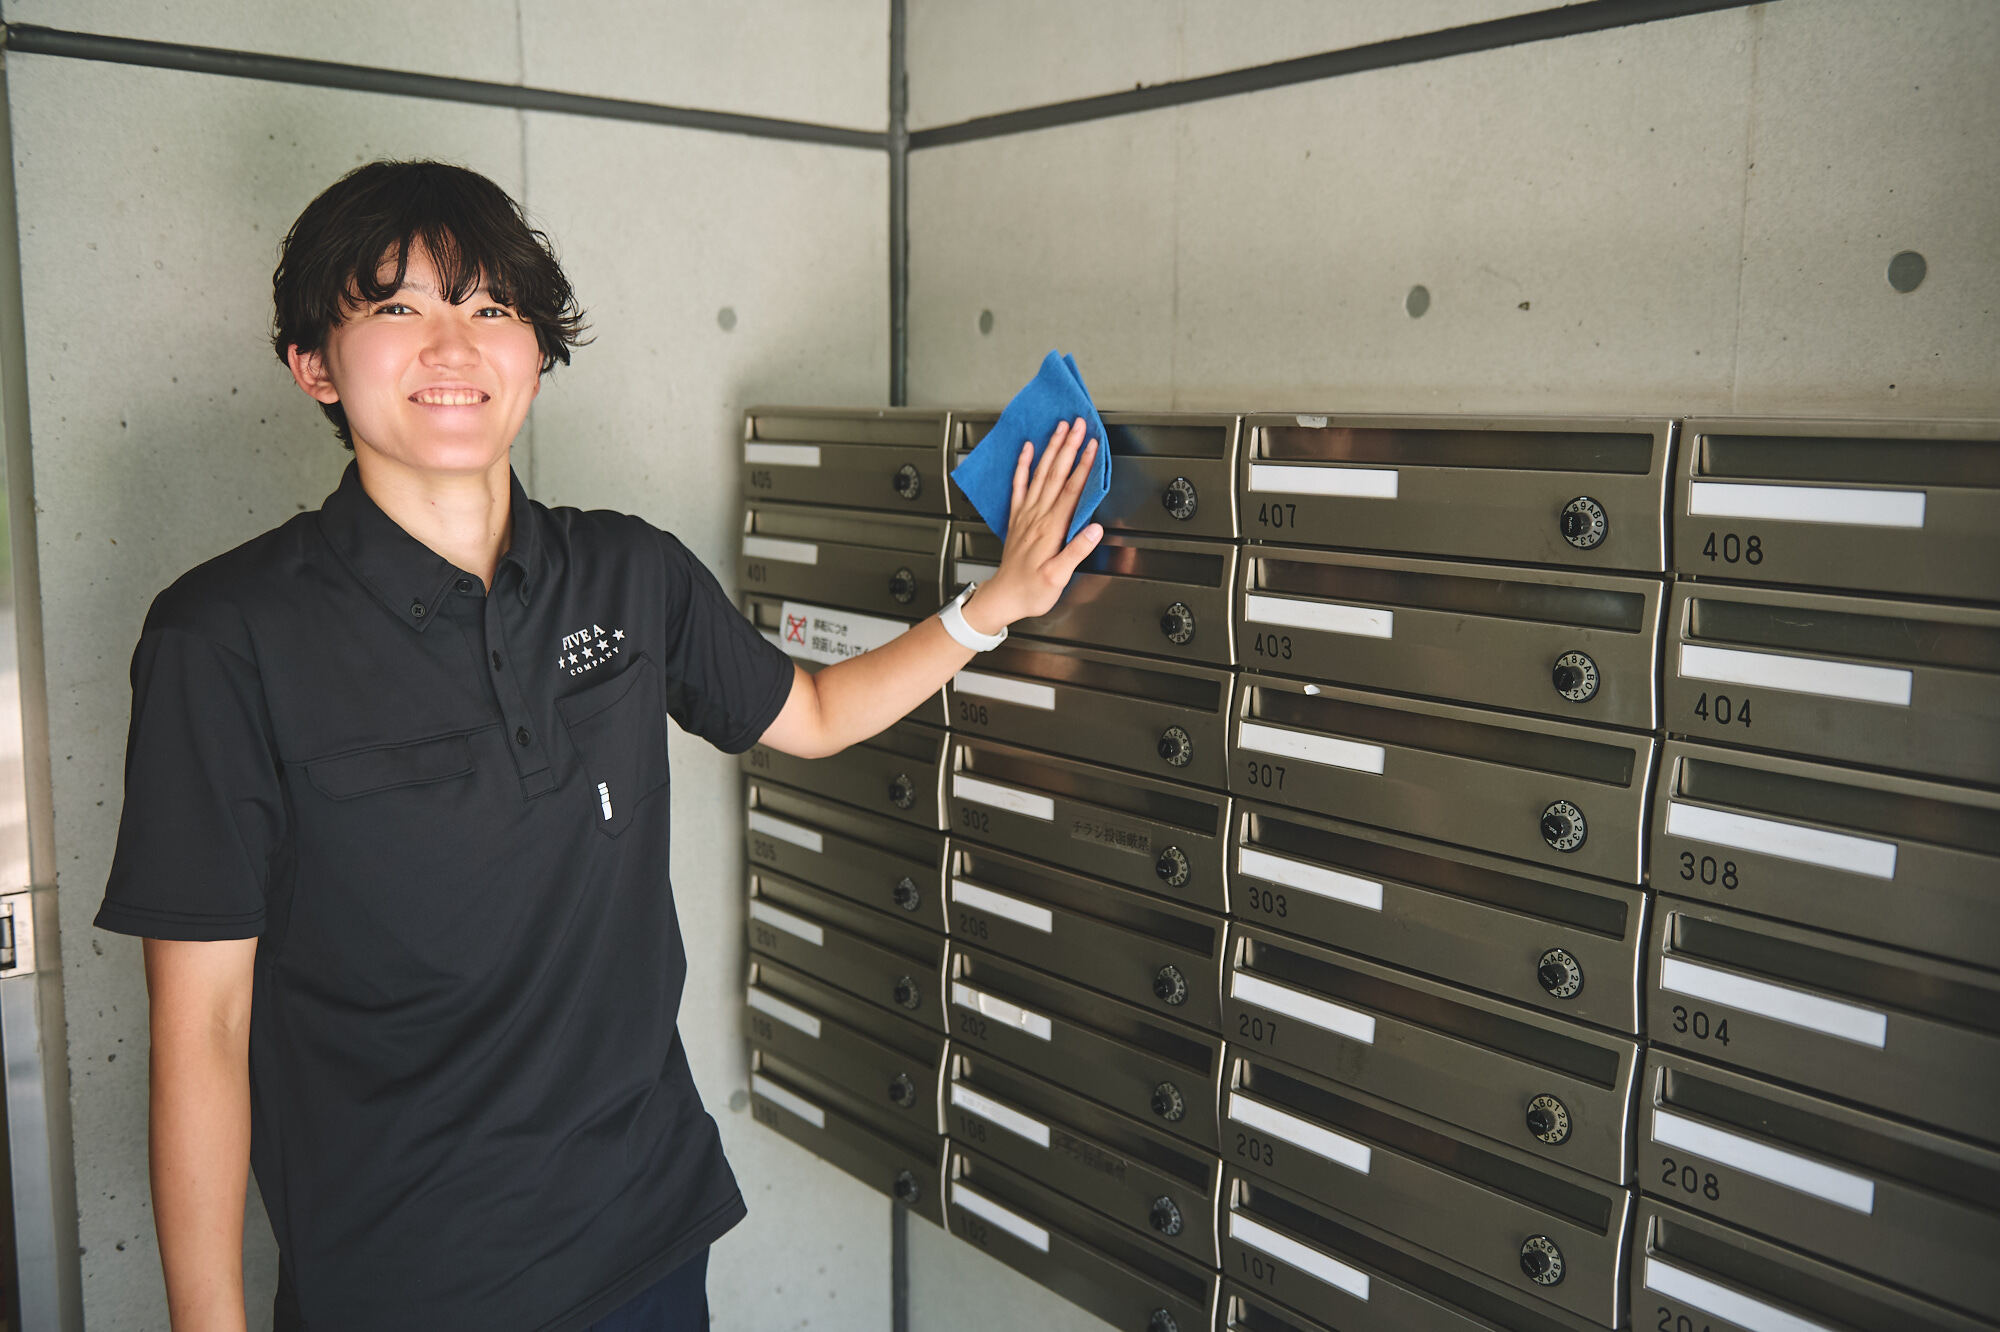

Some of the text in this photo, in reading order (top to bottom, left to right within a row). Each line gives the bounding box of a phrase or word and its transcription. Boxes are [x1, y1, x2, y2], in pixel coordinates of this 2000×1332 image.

[751, 471, 772, 490] 405
[1258, 503, 1297, 529] 407
[1702, 531, 1765, 567] 408
[747, 565, 767, 584] 401
[562, 624, 606, 651] FIVE A
[1254, 633, 1293, 660] 403
[570, 646, 619, 676] COMPANY
[959, 700, 989, 727] 306
[1694, 692, 1753, 729] 404
[1247, 763, 1286, 791] 307
[961, 808, 990, 834] 302
[1680, 851, 1740, 891] 308
[1248, 886, 1288, 918] 303
[959, 914, 989, 940] 206
[961, 1015, 988, 1041] 202
[1238, 1014, 1278, 1046] 207
[1672, 1005, 1731, 1047] 304
[1236, 1133, 1275, 1168] 203
[1661, 1158, 1721, 1202] 208
[960, 1218, 988, 1247] 102
[1241, 1251, 1277, 1286] 107
[1657, 1306, 1710, 1332] 20
